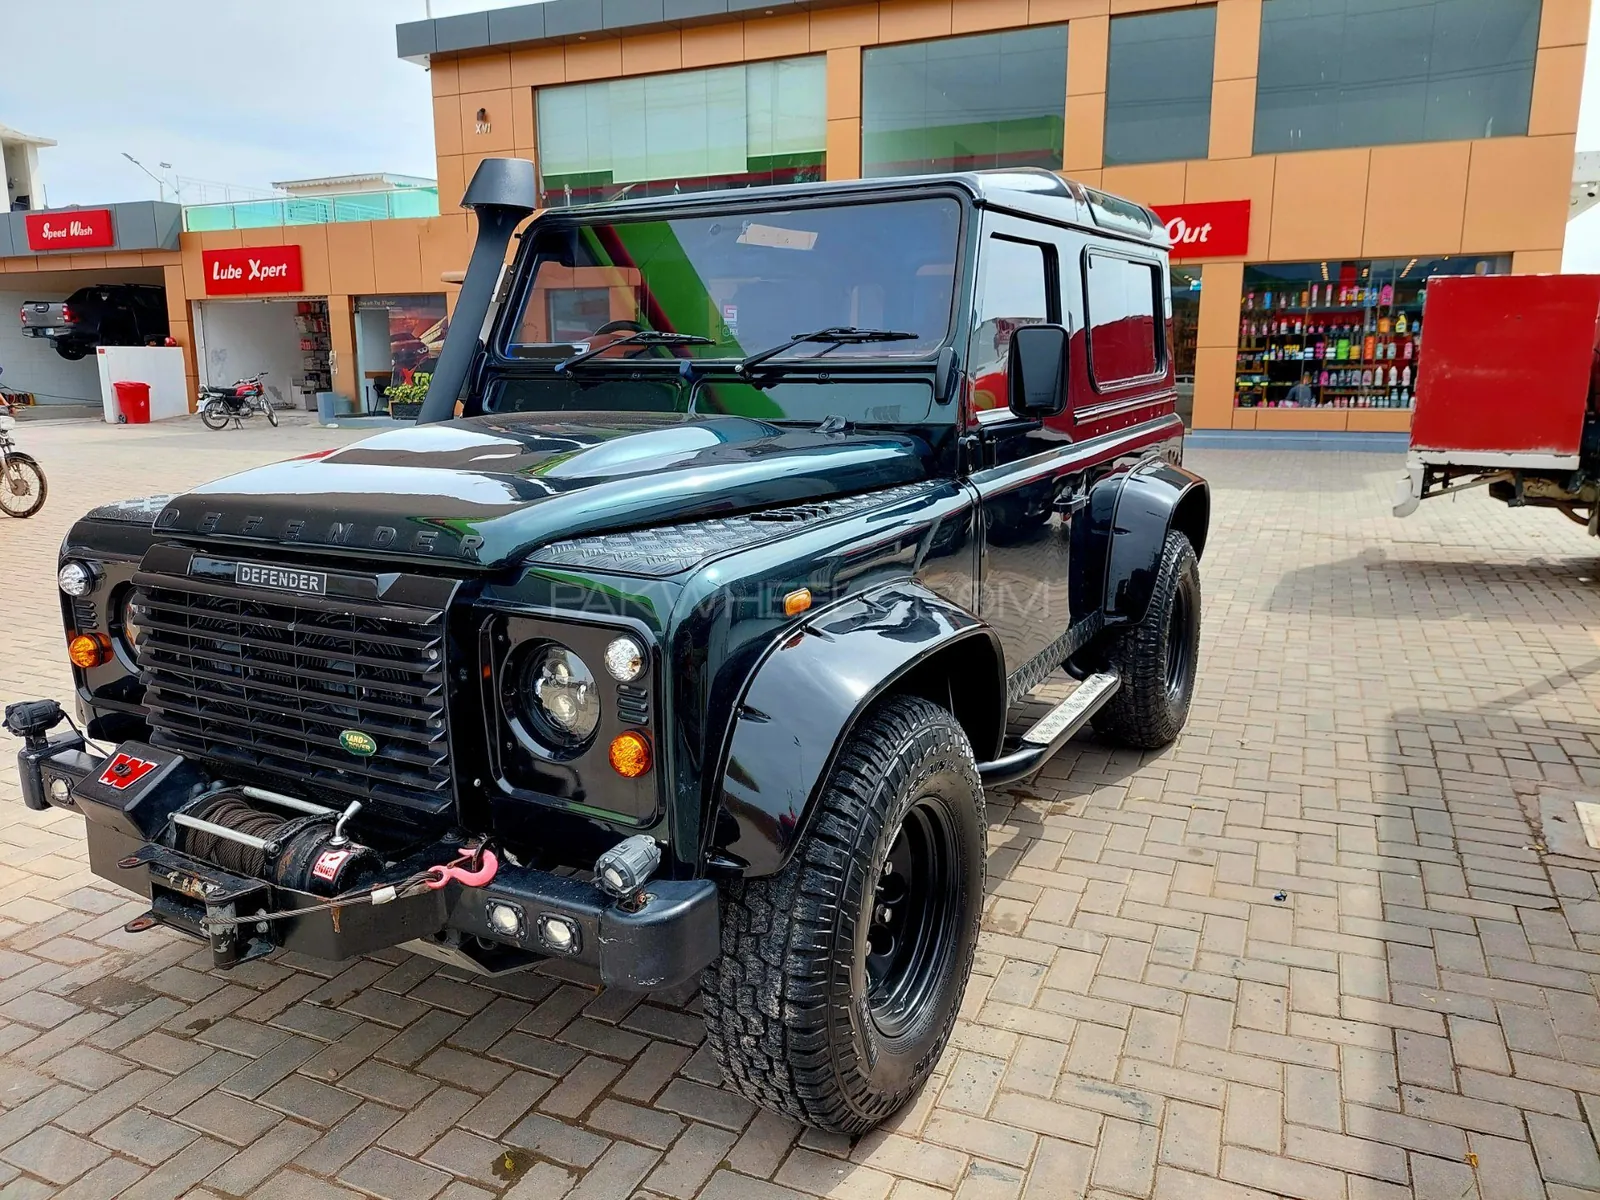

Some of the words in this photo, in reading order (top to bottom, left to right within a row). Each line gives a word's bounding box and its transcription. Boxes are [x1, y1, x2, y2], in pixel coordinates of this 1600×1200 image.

[42, 222, 67, 240] Speed
[70, 220, 93, 236] Wash
[1165, 217, 1212, 245] Out
[213, 261, 243, 280] Lube
[248, 259, 287, 281] Xpert
[157, 507, 486, 559] DEFENDER
[241, 567, 320, 591] DEFENDER
